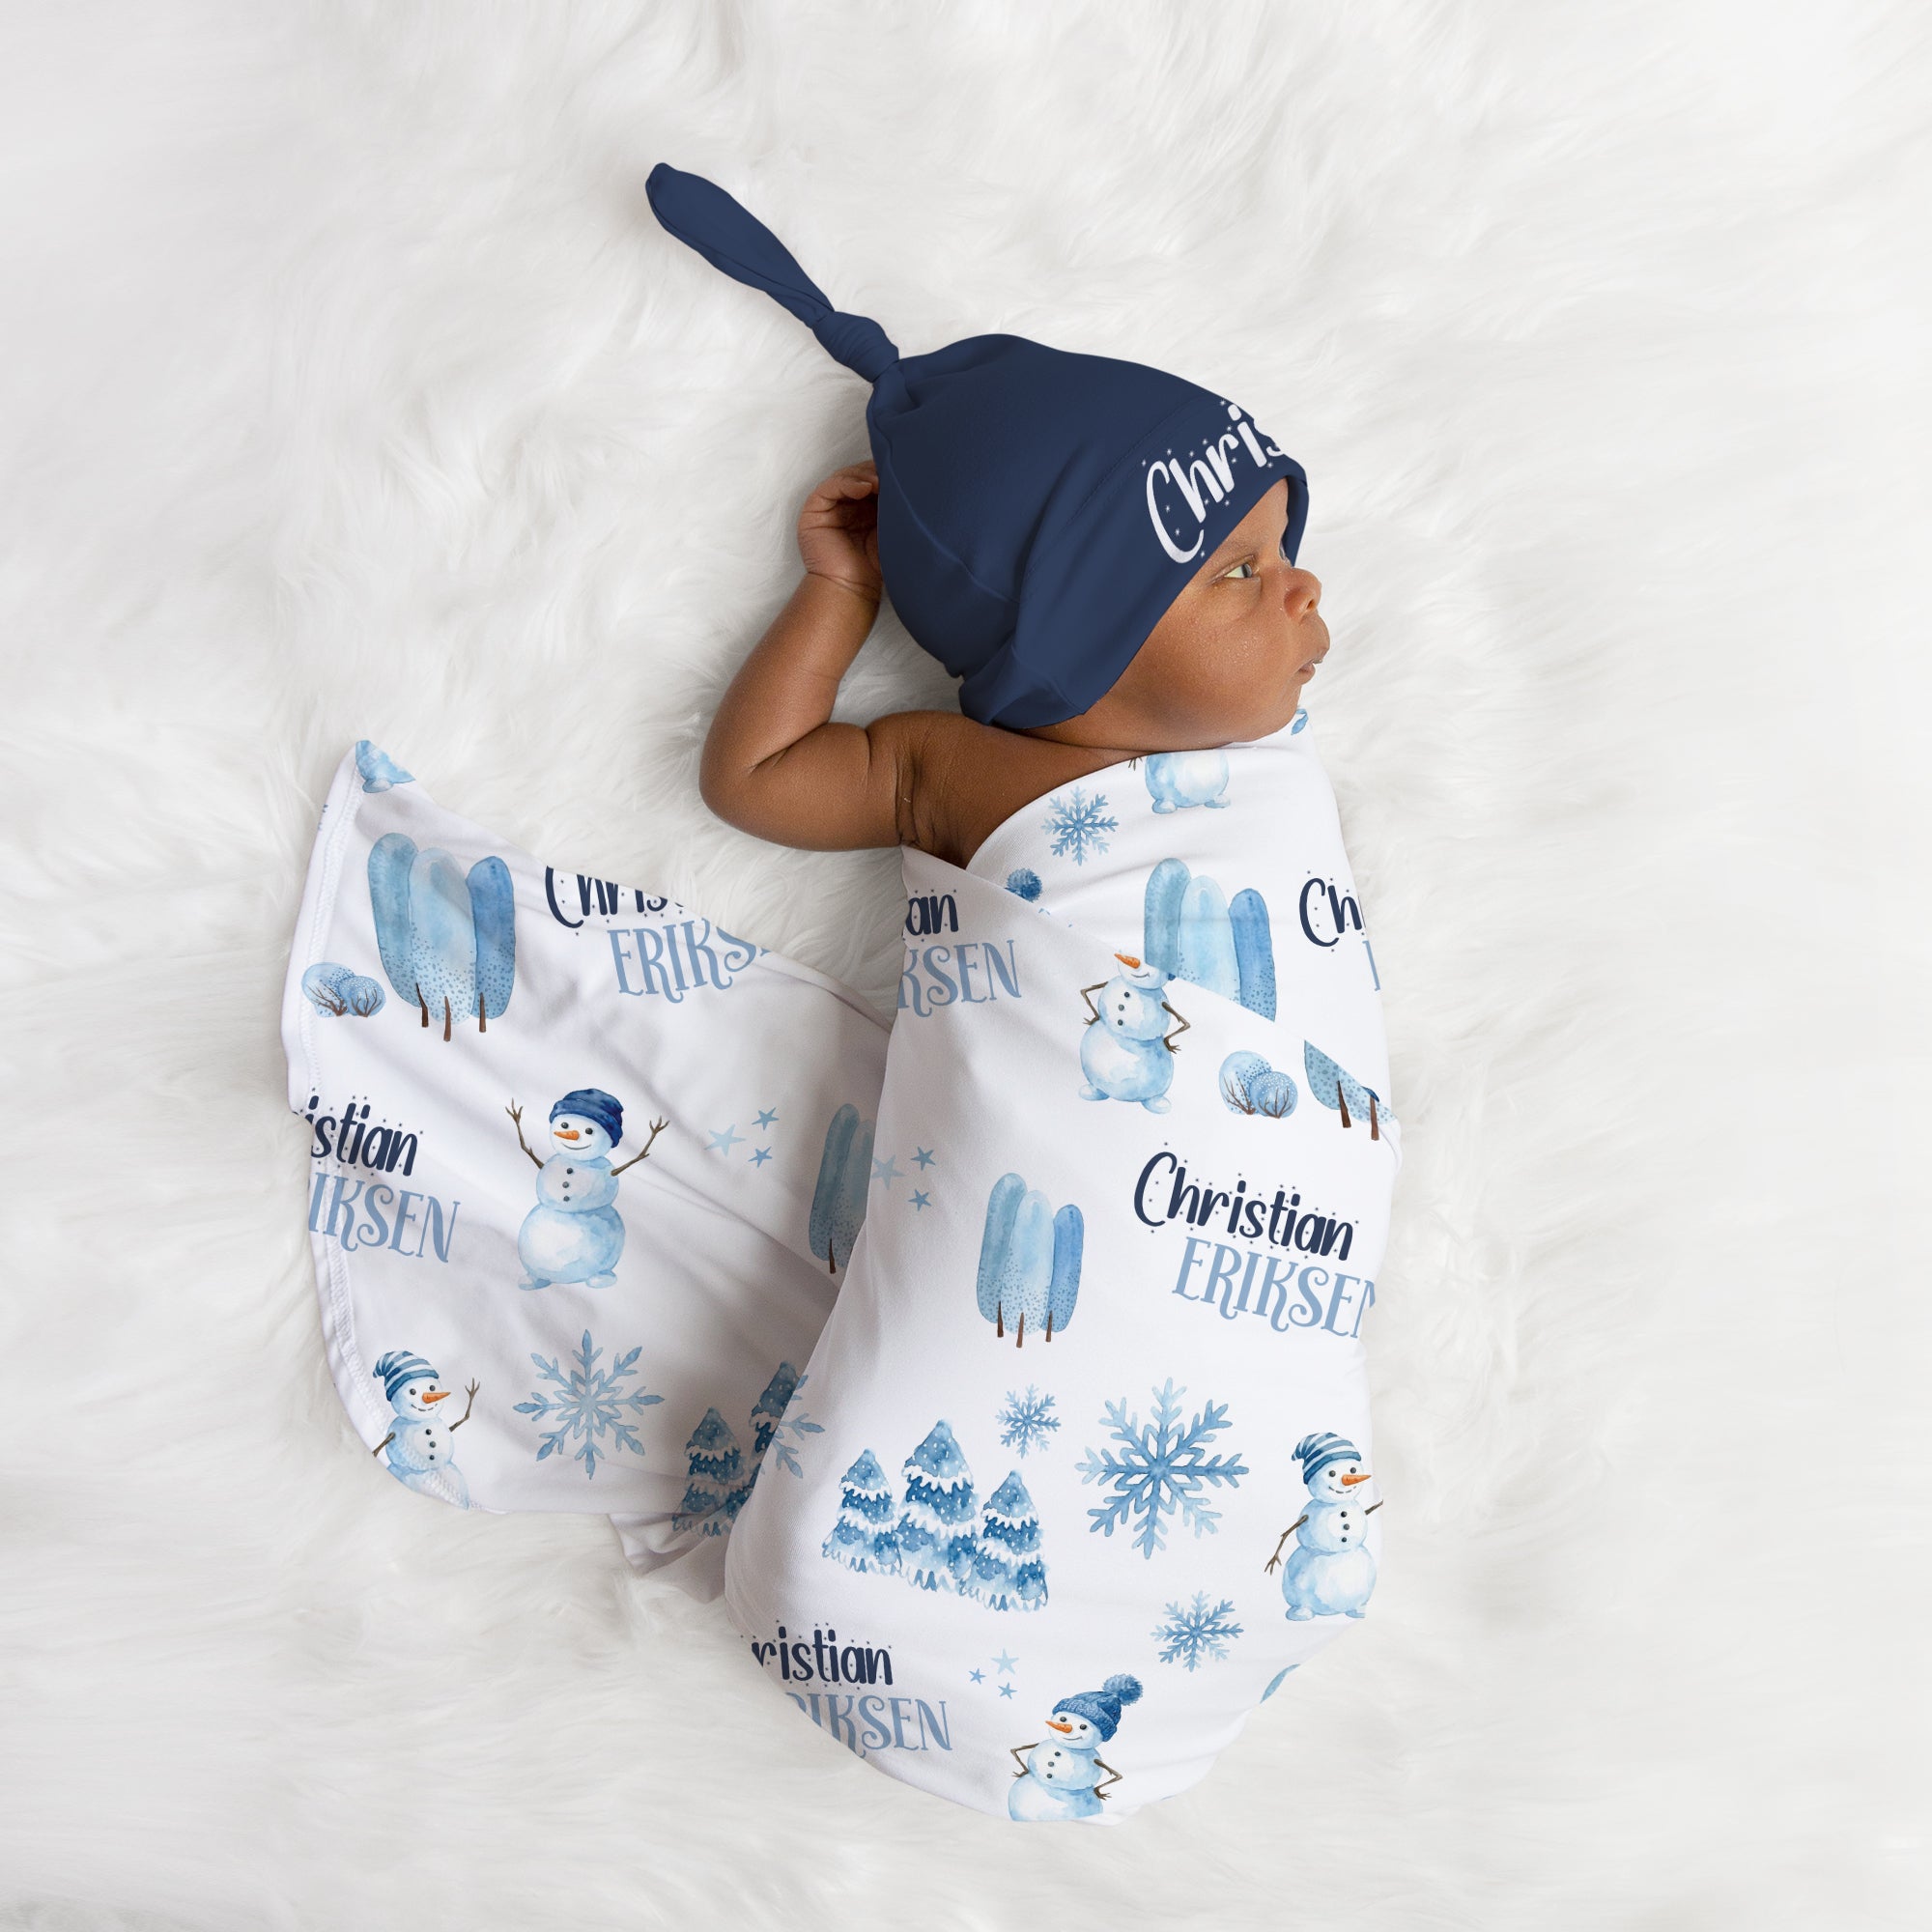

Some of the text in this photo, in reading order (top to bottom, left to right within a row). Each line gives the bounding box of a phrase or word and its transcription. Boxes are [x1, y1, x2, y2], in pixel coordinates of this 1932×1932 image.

[607, 918, 771, 1004] ERIKS
[308, 1172, 461, 1263] IKSEN
[1134, 1151, 1353, 1261] Christian
[785, 1692, 952, 1758] IKSEN
